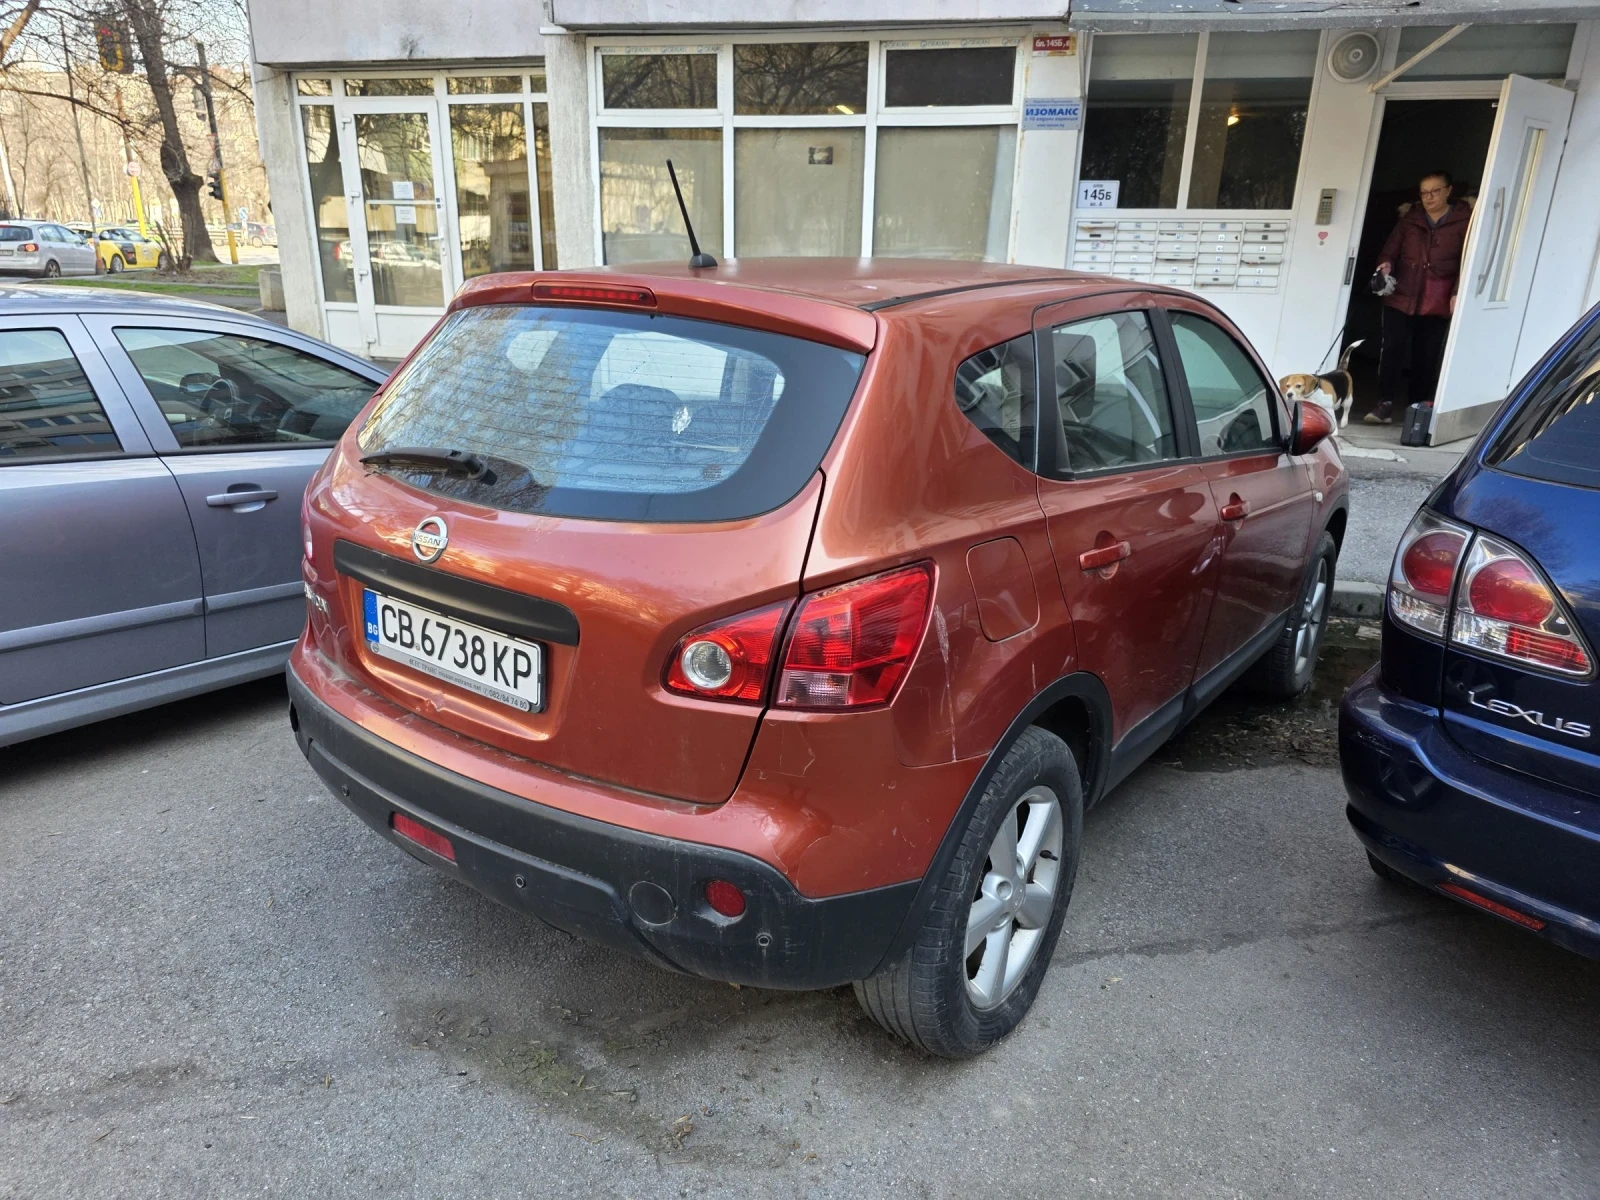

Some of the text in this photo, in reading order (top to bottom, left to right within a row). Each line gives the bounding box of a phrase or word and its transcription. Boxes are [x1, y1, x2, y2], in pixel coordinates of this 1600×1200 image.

[1025, 107, 1079, 116] ИЗОМАКС
[1083, 188, 1112, 201] 145Б
[367, 622, 378, 636] BG
[1468, 690, 1591, 738] LEXUS
